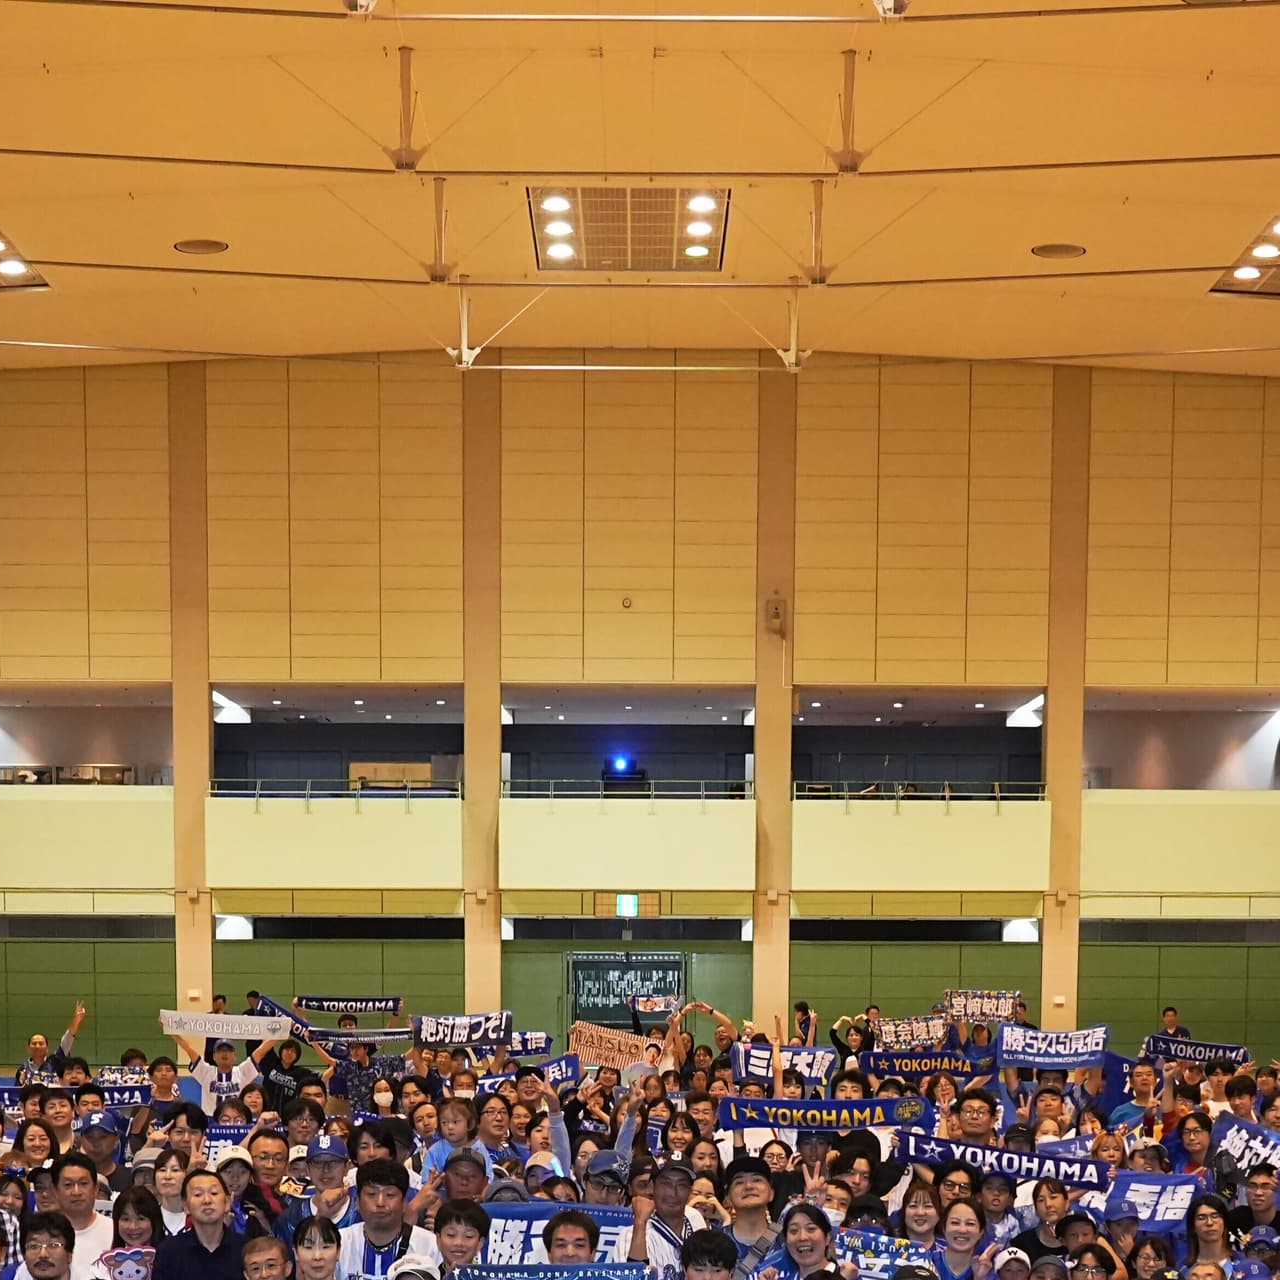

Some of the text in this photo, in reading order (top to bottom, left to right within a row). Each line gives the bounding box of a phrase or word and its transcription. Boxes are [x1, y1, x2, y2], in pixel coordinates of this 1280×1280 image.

[322, 1001, 394, 1013] YOKOHAMA
[188, 1018, 261, 1035] YOKOHAMA
[576, 1029, 640, 1055] TATSUO
[1168, 1041, 1245, 1063] YOKOHAMA
[893, 1057, 972, 1074] YOKOHAMA
[763, 1105, 885, 1127] YOKOHAMA
[949, 1141, 1098, 1186] YOKOHAMA
[467, 1267, 529, 1279] YOKOHAMA
